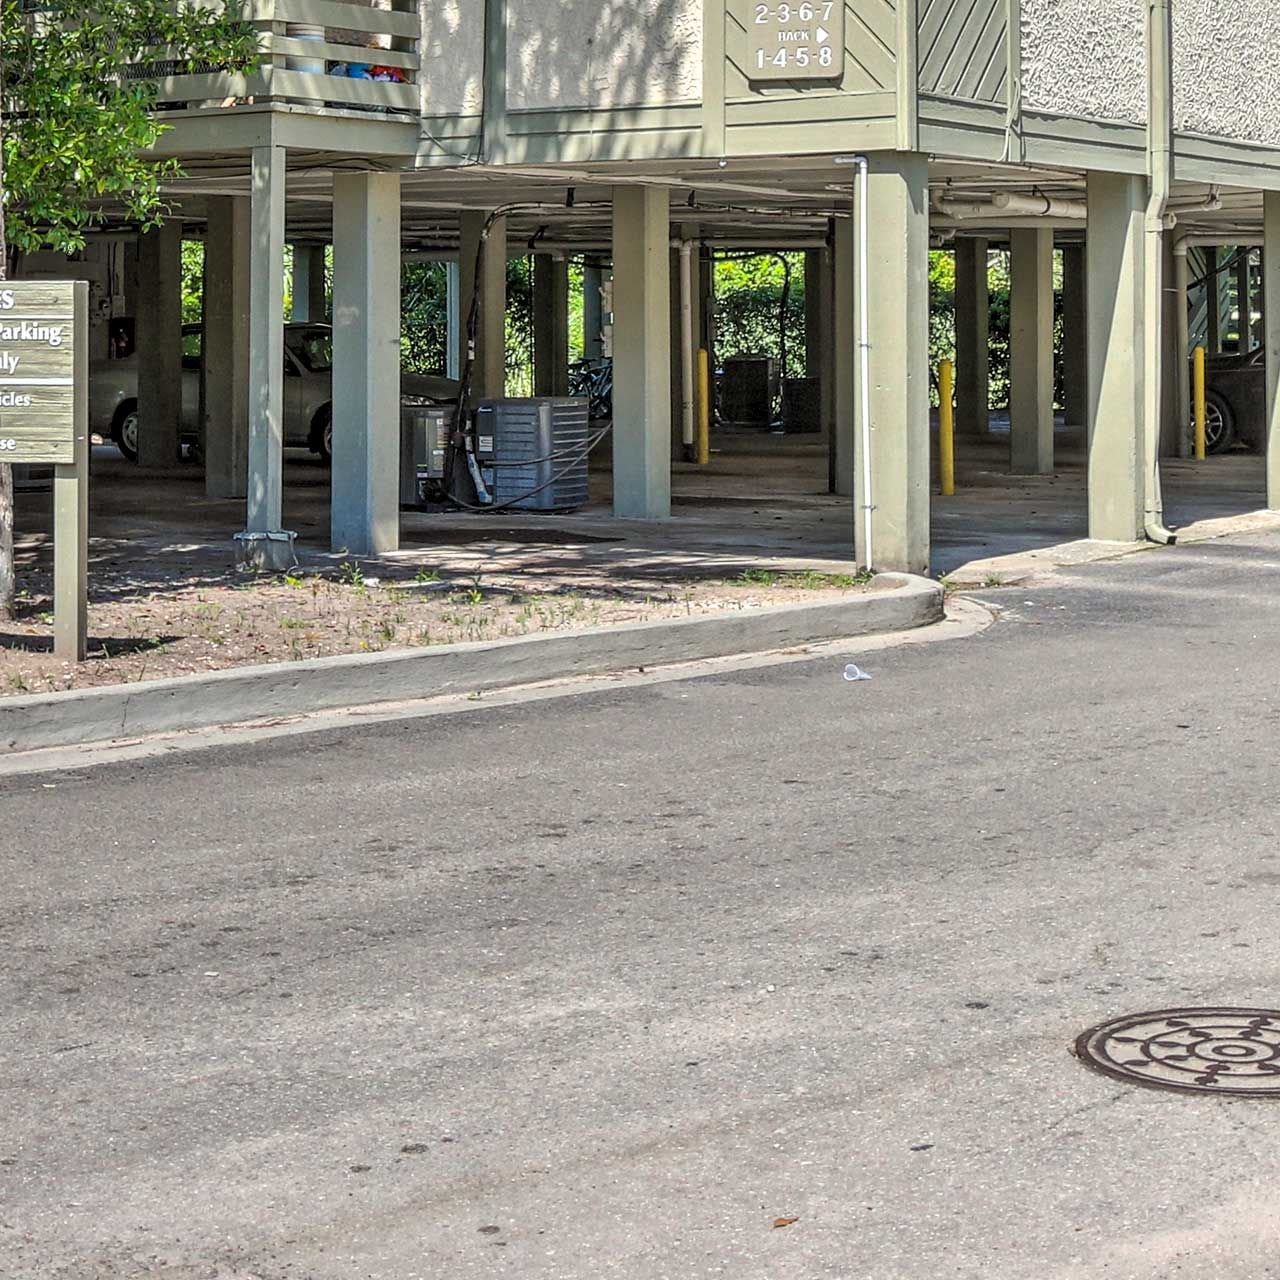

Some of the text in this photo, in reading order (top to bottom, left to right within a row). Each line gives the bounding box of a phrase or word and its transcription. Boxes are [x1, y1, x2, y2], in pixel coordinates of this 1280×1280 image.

[754, 1, 834, 24] 2-3-6-7
[777, 30, 810, 42] BACK
[755, 46, 832, 69] 1-4-5-8
